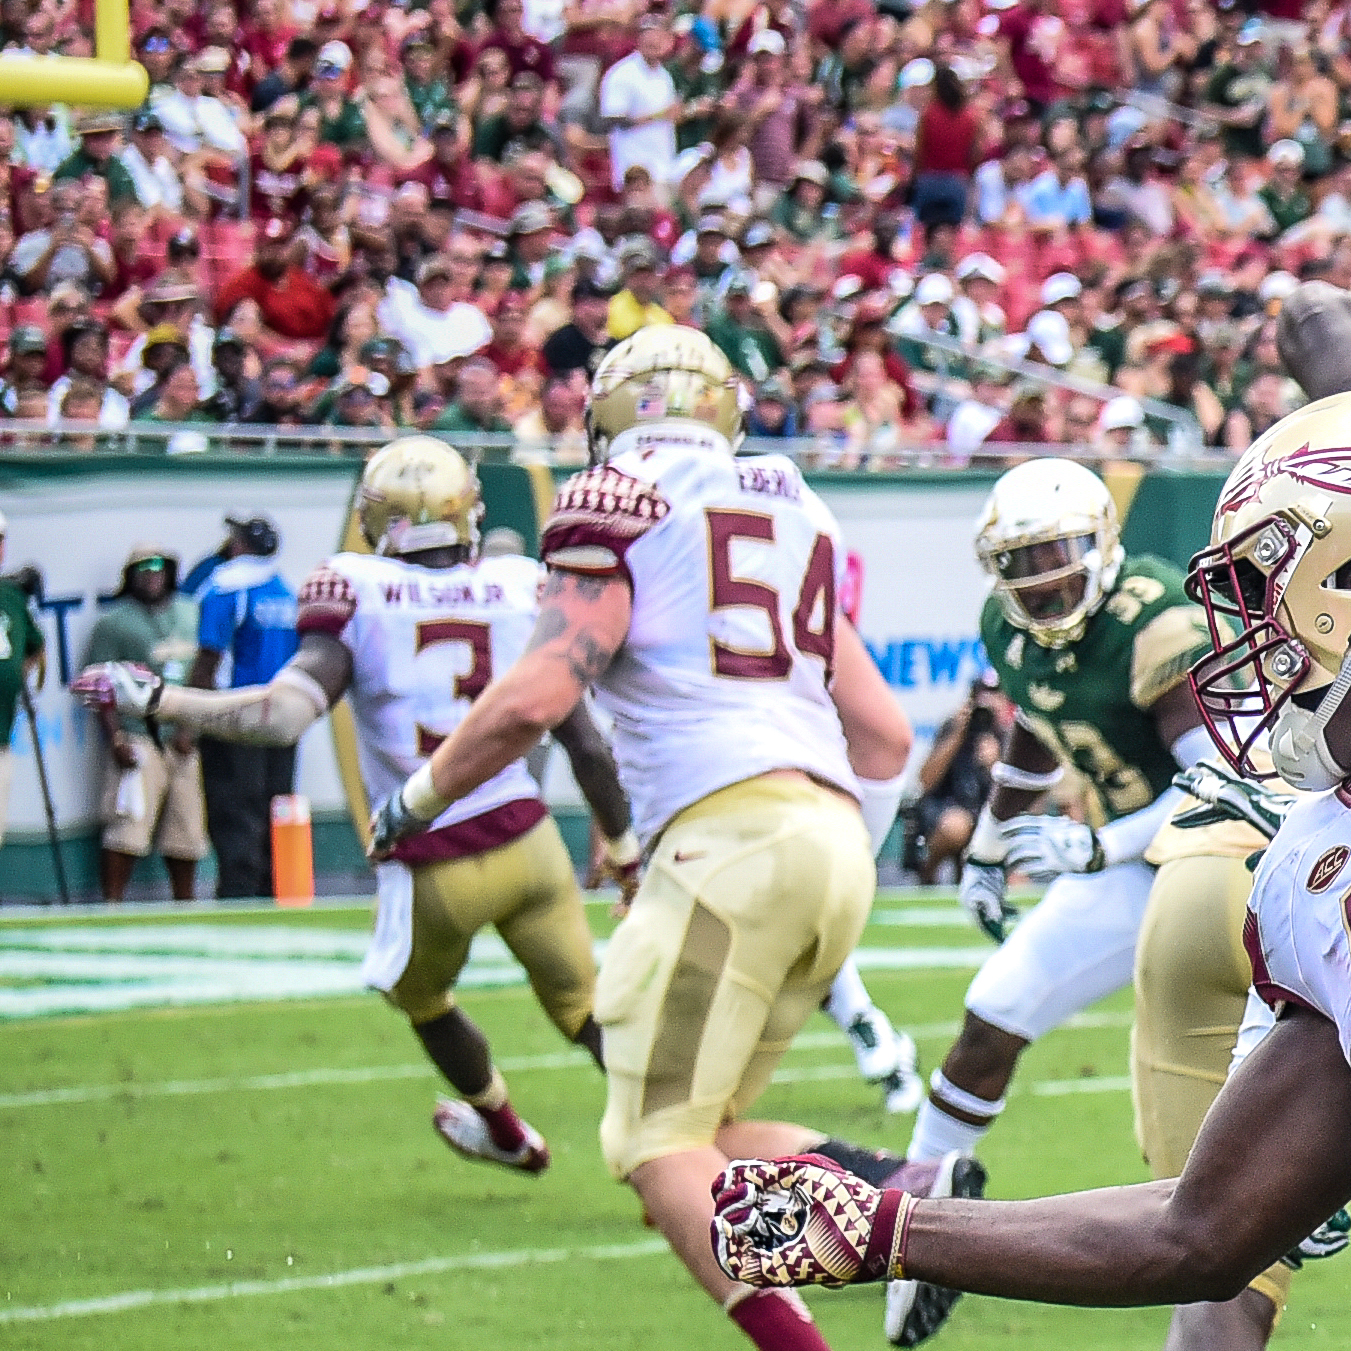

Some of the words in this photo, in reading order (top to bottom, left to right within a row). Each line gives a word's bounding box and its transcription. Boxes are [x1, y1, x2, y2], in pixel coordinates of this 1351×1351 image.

[703, 508, 837, 691] 54
[415, 619, 492, 756] 3
[1314, 845, 1346, 880] ACC
